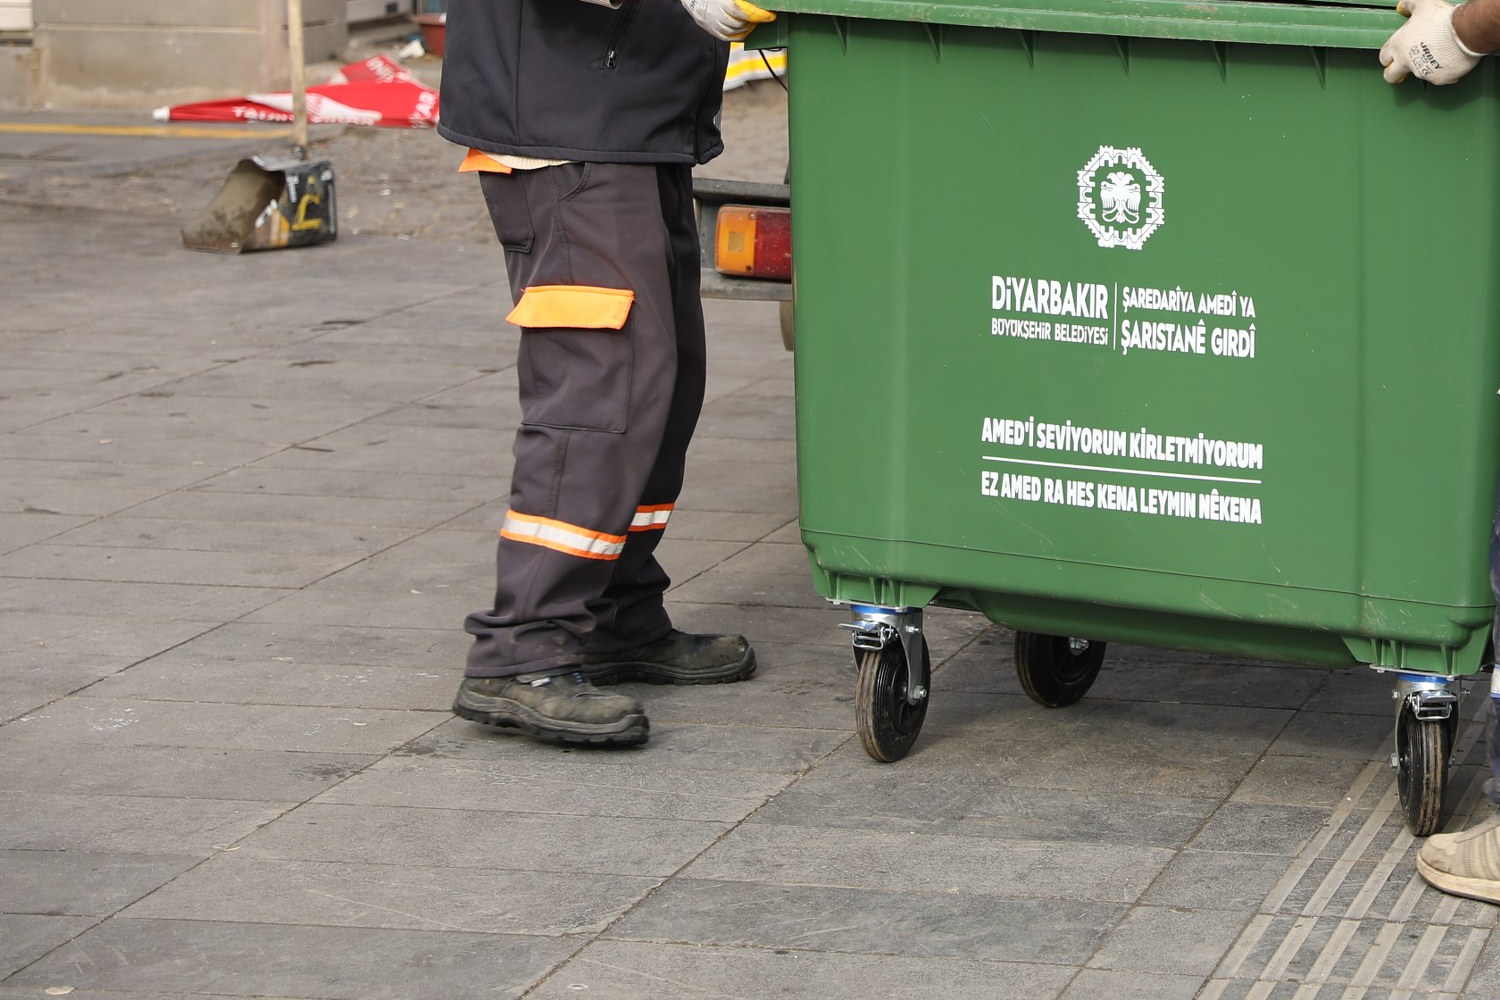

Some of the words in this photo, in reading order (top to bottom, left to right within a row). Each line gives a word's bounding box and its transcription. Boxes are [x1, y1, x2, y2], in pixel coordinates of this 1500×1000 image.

[1122, 285, 1195, 313] ŞAREDARÎYA
[1197, 290, 1237, 317] AMEDÎ
[1239, 296, 1256, 318] YA
[1121, 318, 1206, 355] ŞARISTANÊ
[1211, 322, 1256, 359] GIRDÎ
[982, 416, 1034, 447] AMED'İ
[1036, 420, 1126, 457] SEVİYORUM
[1129, 427, 1263, 469] KİRLETMİYORUM
[982, 470, 999, 497] EZ
[1001, 473, 1041, 502] AMED
[1044, 477, 1064, 504] RA
[1067, 480, 1095, 508] HES
[1097, 484, 1138, 513] KENA
[1140, 488, 1196, 518] LEYMIN
[1199, 488, 1262, 525] NÊKENA
